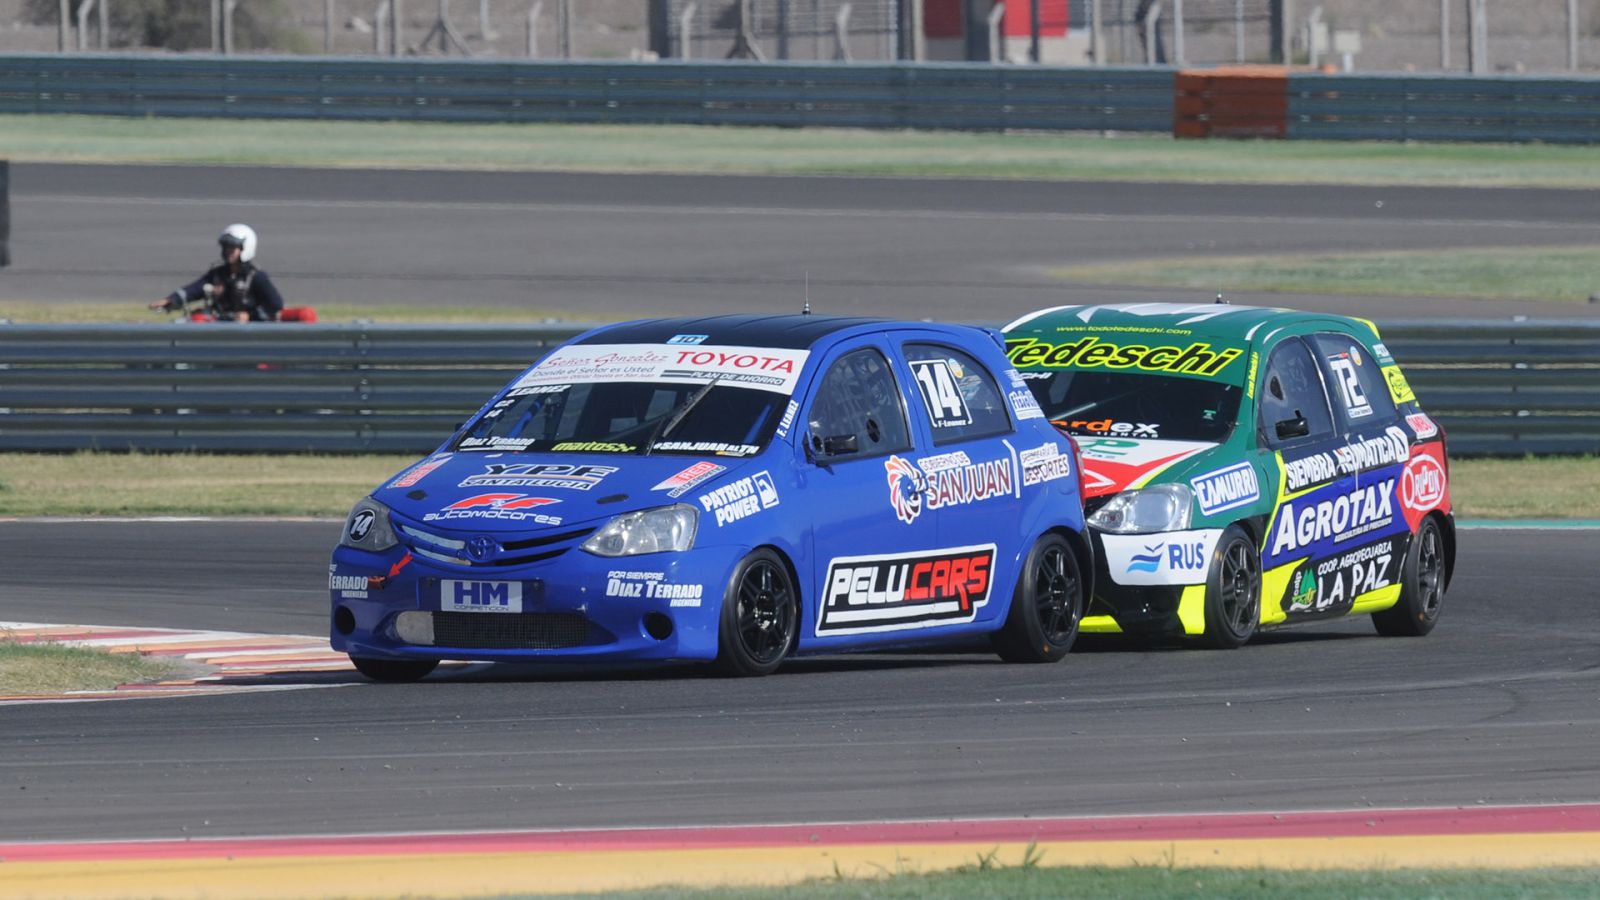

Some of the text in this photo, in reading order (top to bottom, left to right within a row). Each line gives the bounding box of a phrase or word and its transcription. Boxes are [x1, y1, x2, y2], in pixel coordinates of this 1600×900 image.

[1055, 325, 1193, 337] www.todotedeschi.com
[623, 366, 656, 374] Usted
[676, 351, 794, 373] TOYOTA
[1004, 336, 1244, 376] Tedeschi
[690, 371, 718, 380] PLAN
[734, 374, 784, 386] AHORRO
[916, 363, 962, 419] 14
[782, 399, 800, 430] LEANEZ
[460, 476, 526, 490] SANTA
[484, 463, 620, 480] YPF
[926, 459, 1012, 508] SAN JUAN
[1024, 457, 1069, 484] DEPORTES
[1285, 452, 1337, 490] SIEMBRA
[699, 477, 756, 513] PATRIOT
[1200, 466, 1257, 508] CAMURRI
[423, 510, 563, 526] automotores
[715, 494, 762, 528] POWER
[1271, 478, 1395, 556] AGROTAX
[349, 514, 374, 537] 14
[1168, 542, 1205, 571] RUS
[606, 578, 703, 599] DIAZ TERRADO
[607, 570, 627, 579] POR
[827, 555, 990, 611] PELU.CARS
[1316, 554, 1392, 609] LA PAZ
[453, 581, 509, 606] HM
